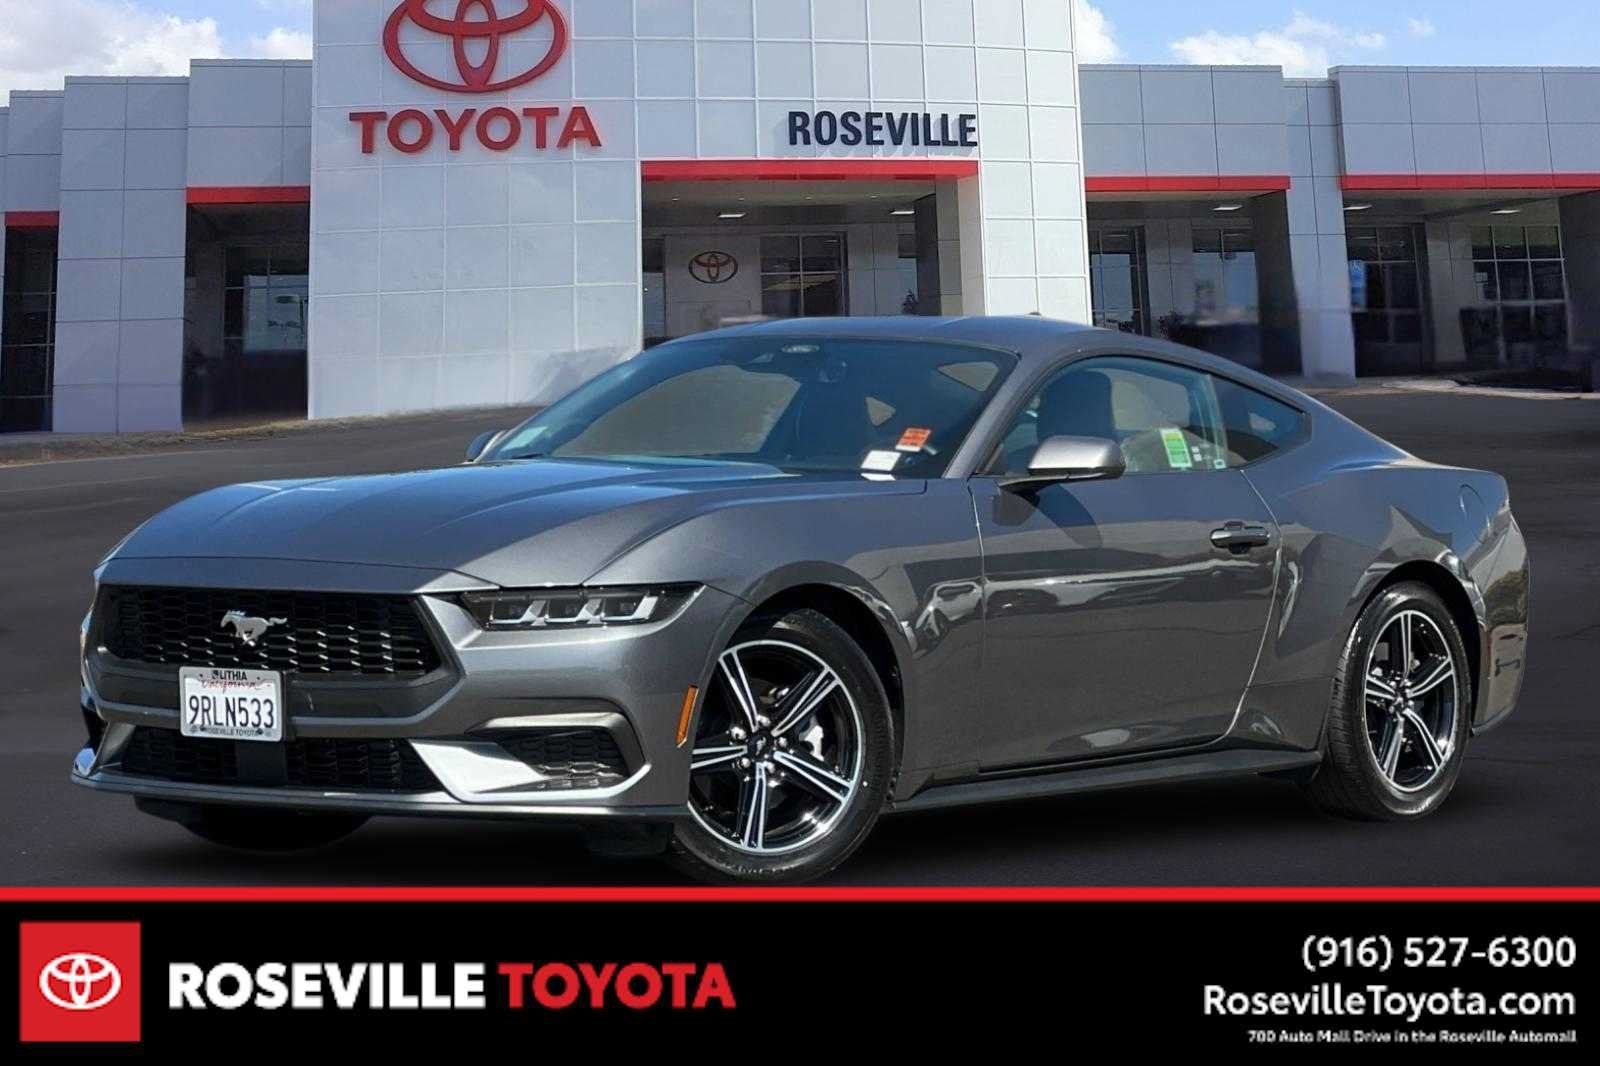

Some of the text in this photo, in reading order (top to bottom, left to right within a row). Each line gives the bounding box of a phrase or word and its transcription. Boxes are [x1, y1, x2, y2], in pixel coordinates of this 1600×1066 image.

[350, 106, 602, 154] TOYOTA
[788, 111, 978, 147] ROSEVILLE
[219, 670, 248, 681] LITHIA
[189, 695, 274, 728] 9RLN533
